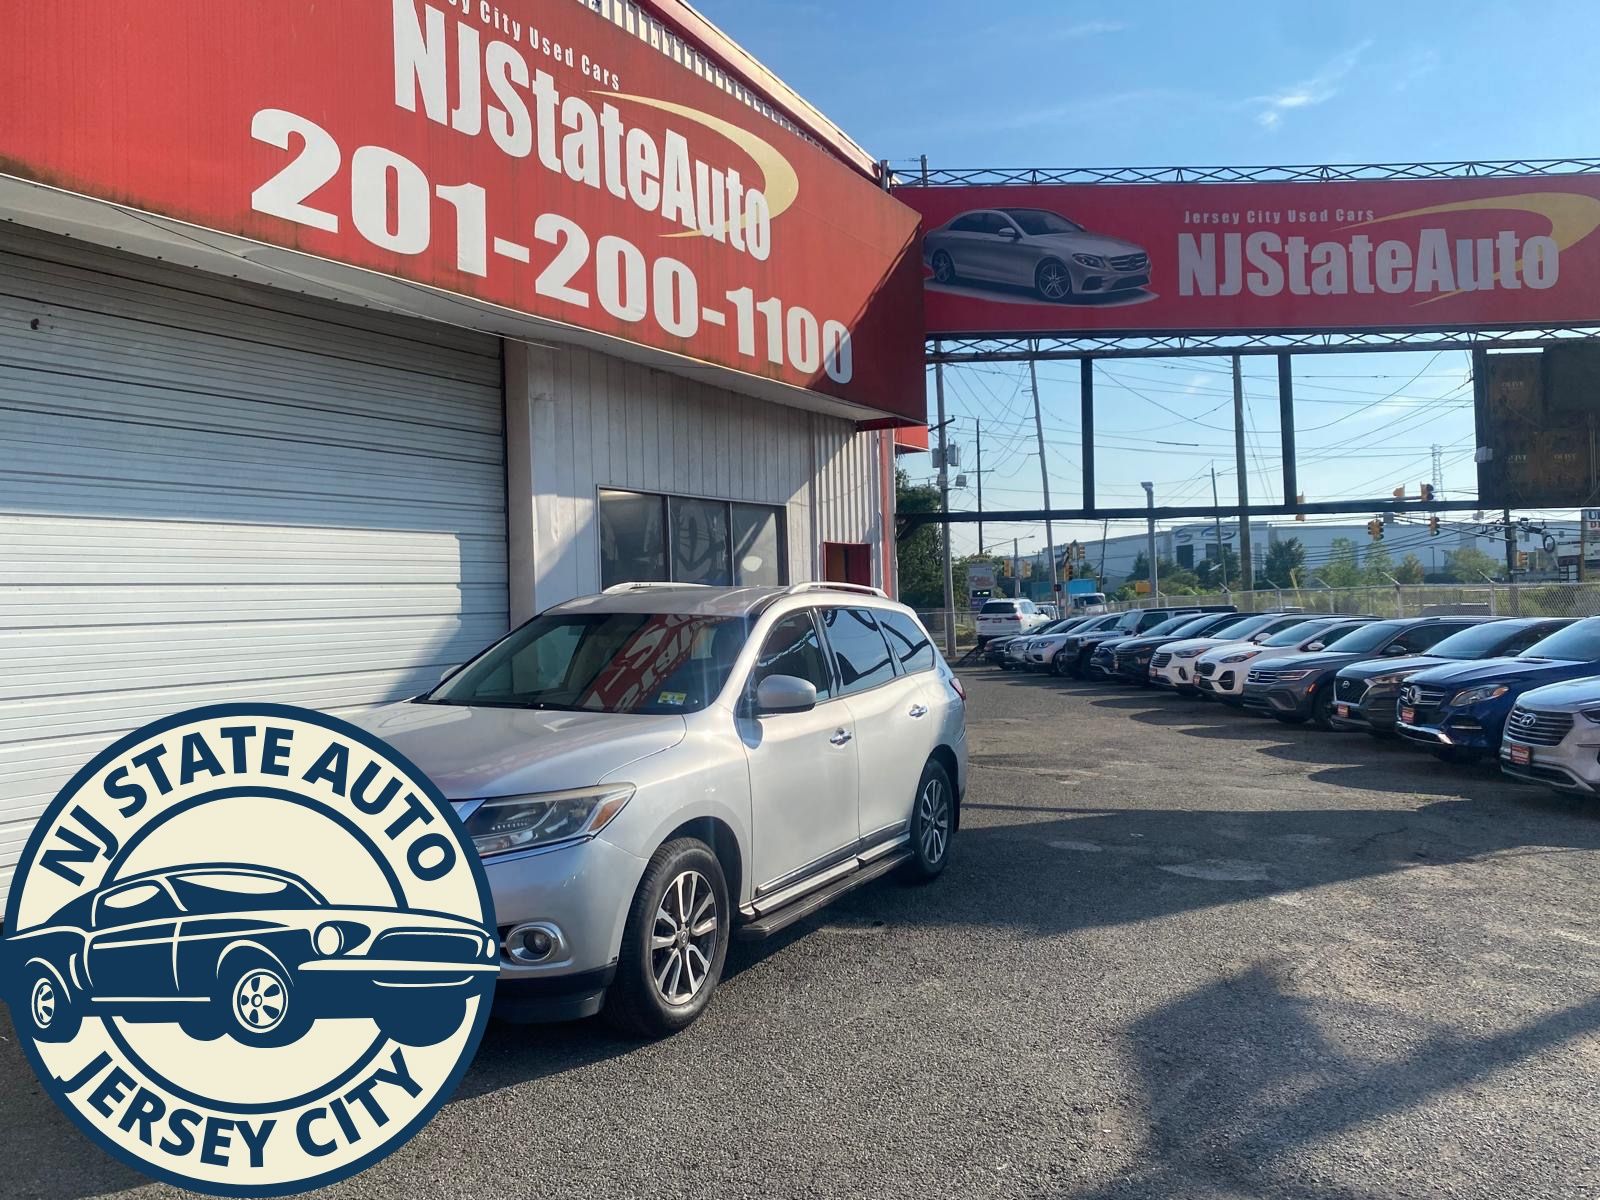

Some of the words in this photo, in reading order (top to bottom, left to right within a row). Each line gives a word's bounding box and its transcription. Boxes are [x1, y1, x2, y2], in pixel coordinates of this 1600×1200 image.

[480, 0, 521, 42] City
[529, 26, 574, 67] Used
[581, 54, 620, 91] Cars
[393, 0, 771, 262] NJStateAuto
[251, 108, 853, 384] 201-200-1100
[1177, 228, 1560, 297] NJStateAuto
[1184, 211, 1240, 226] Jersey
[1246, 210, 1281, 226] City
[1287, 209, 1329, 223] Used
[1335, 208, 1375, 222] Cars
